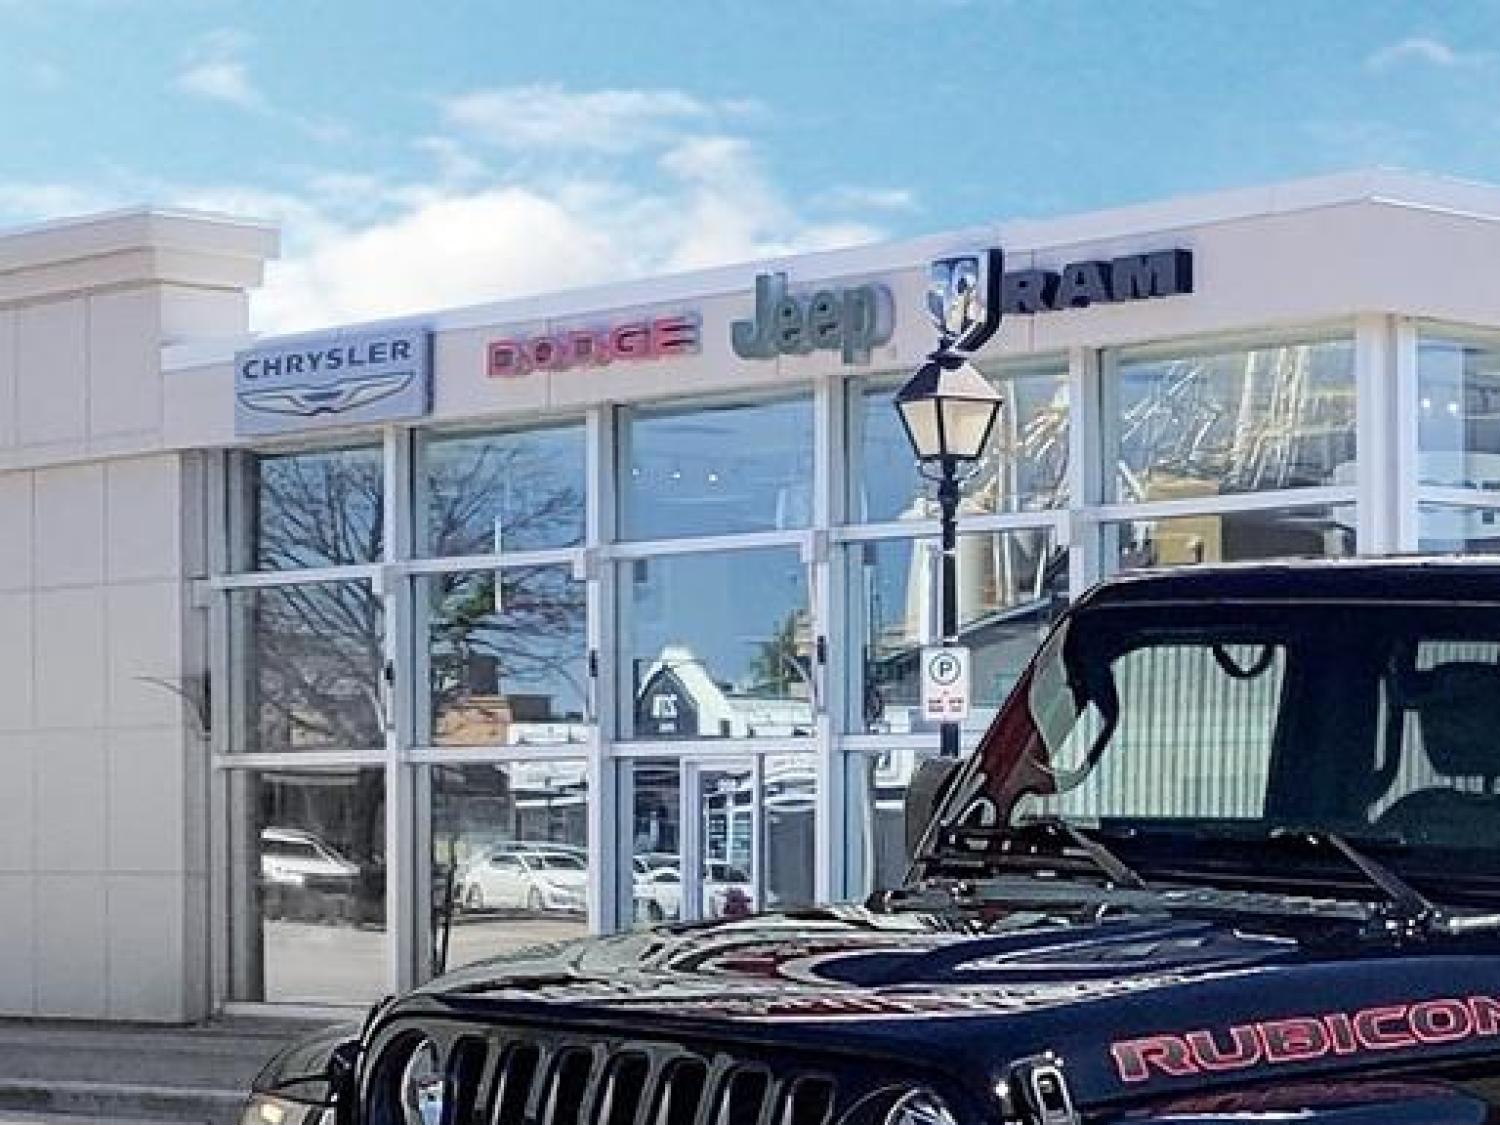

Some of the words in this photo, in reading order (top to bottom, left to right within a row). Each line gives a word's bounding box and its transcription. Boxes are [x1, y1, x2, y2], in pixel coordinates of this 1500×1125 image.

[1002, 249, 1193, 314] RAM
[487, 313, 702, 377] DODGE
[731, 271, 896, 365] Jeep
[242, 339, 411, 379] CHRYSLER
